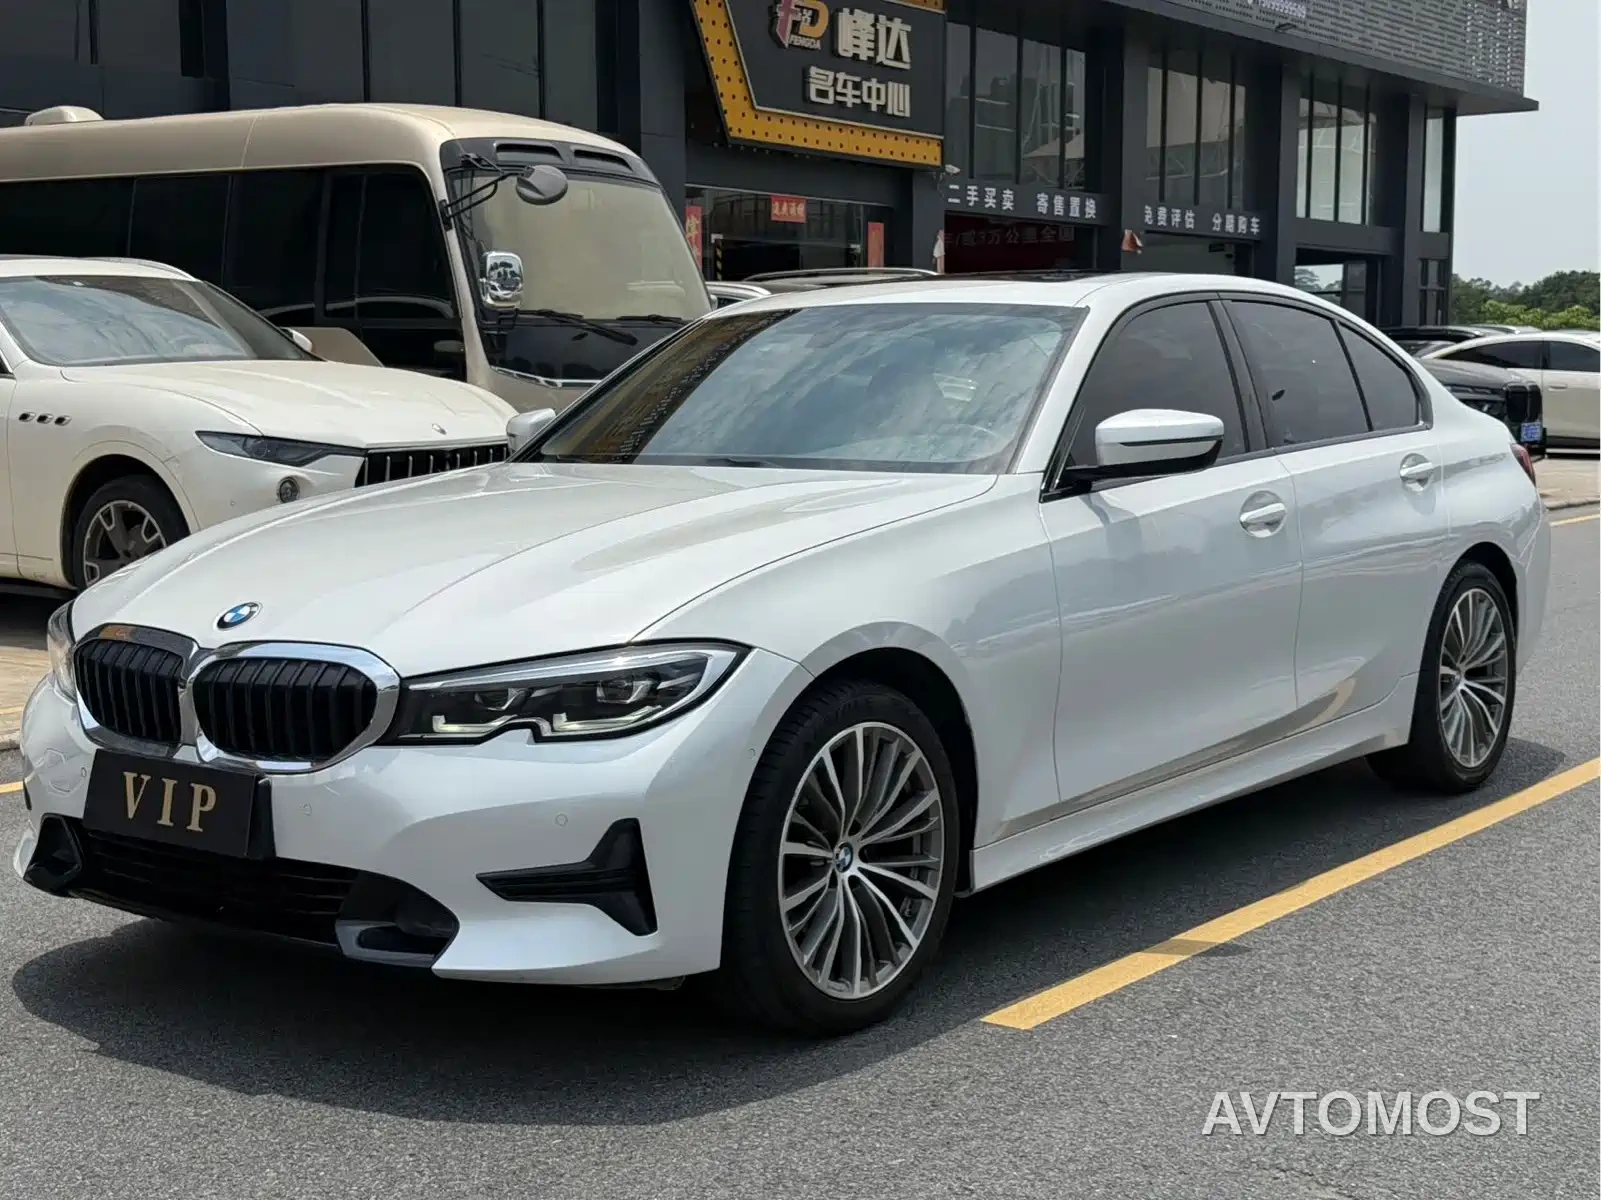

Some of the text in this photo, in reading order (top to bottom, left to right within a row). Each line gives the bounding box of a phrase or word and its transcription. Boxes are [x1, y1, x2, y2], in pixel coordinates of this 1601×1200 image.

[838, 7, 912, 70] 峰达
[809, 66, 911, 117] 名车中心
[948, 183, 1097, 219] 二手买卖 寄售置换
[1144, 204, 1260, 235] 免费评估 分期购车
[122, 772, 217, 832] VIP
